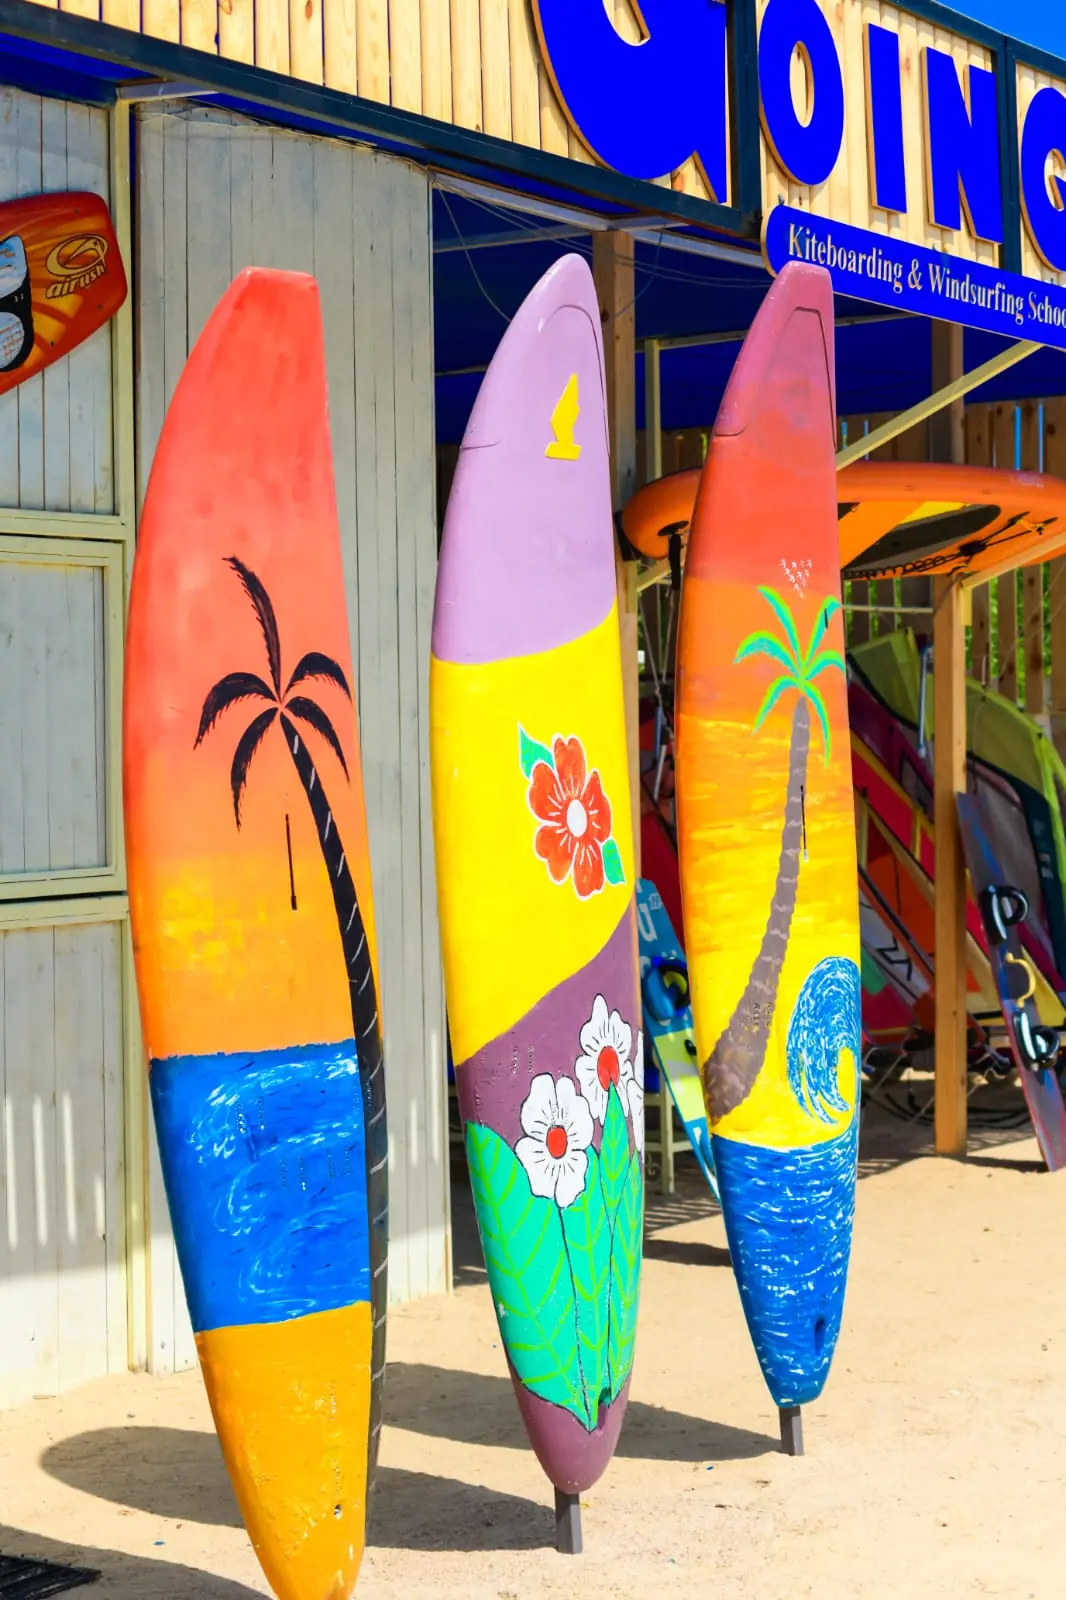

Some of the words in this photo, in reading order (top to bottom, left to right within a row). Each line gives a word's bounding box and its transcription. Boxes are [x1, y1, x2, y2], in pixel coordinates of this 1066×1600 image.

[46, 265, 105, 299] airush
[788, 223, 903, 294] Kiteboarding
[907, 258, 923, 291] &
[928, 262, 1025, 326] Windsurfing
